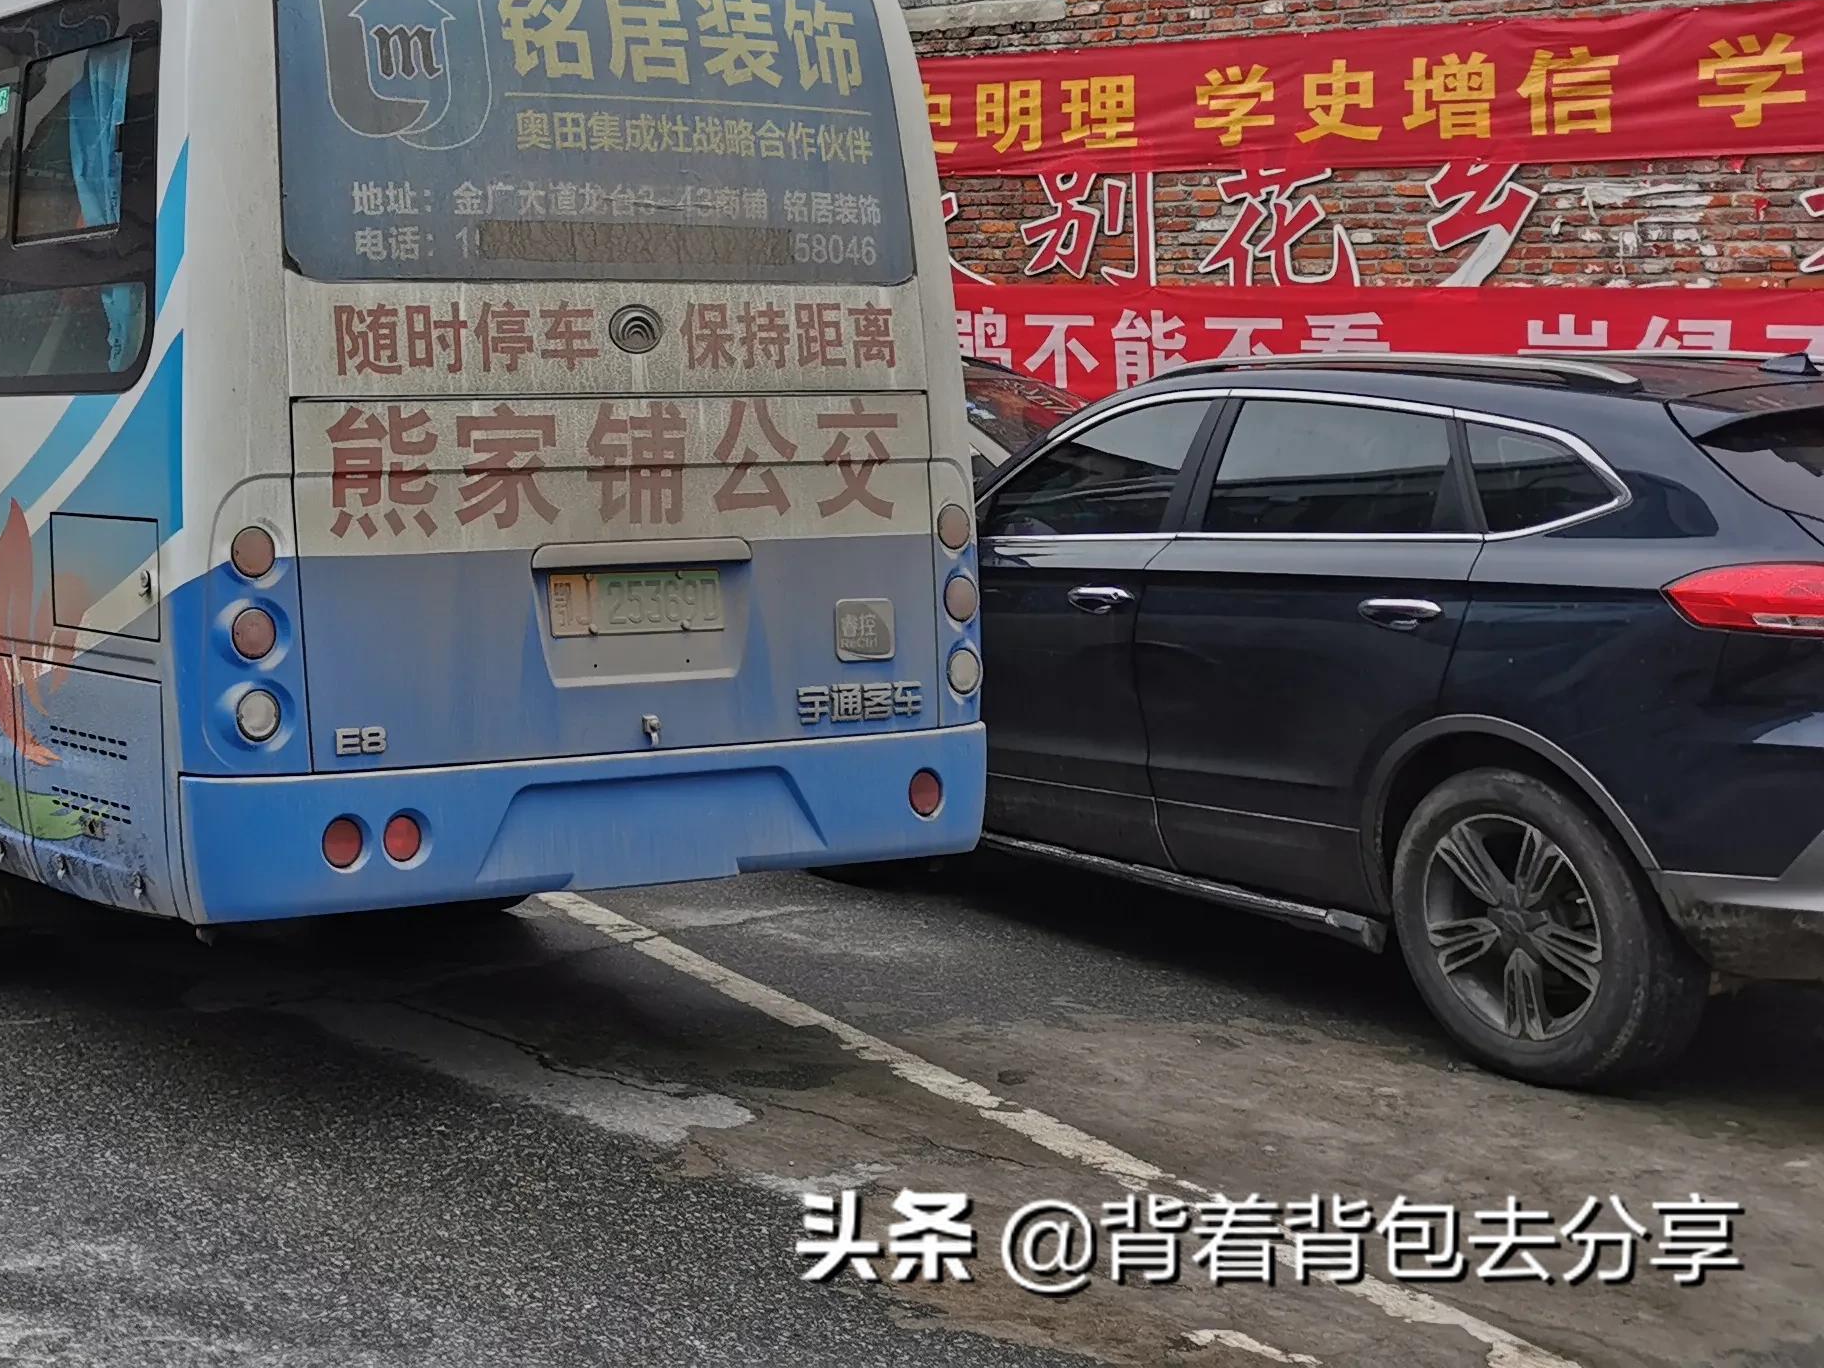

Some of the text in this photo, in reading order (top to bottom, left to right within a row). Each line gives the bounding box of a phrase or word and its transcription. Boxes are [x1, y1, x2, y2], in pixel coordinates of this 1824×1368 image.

[1194, 44, 1621, 148] 学史增信
[1697, 32, 1805, 130] 学
[516, 109, 874, 165] 奥田集成灶战略合作伙伴
[783, 189, 882, 226] 铭居装饰
[333, 301, 897, 377] 随时停车 保持距离
[328, 398, 899, 540] 熊家铺公交
[796, 680, 924, 725] 宇通客车
[335, 726, 388, 756] E8
